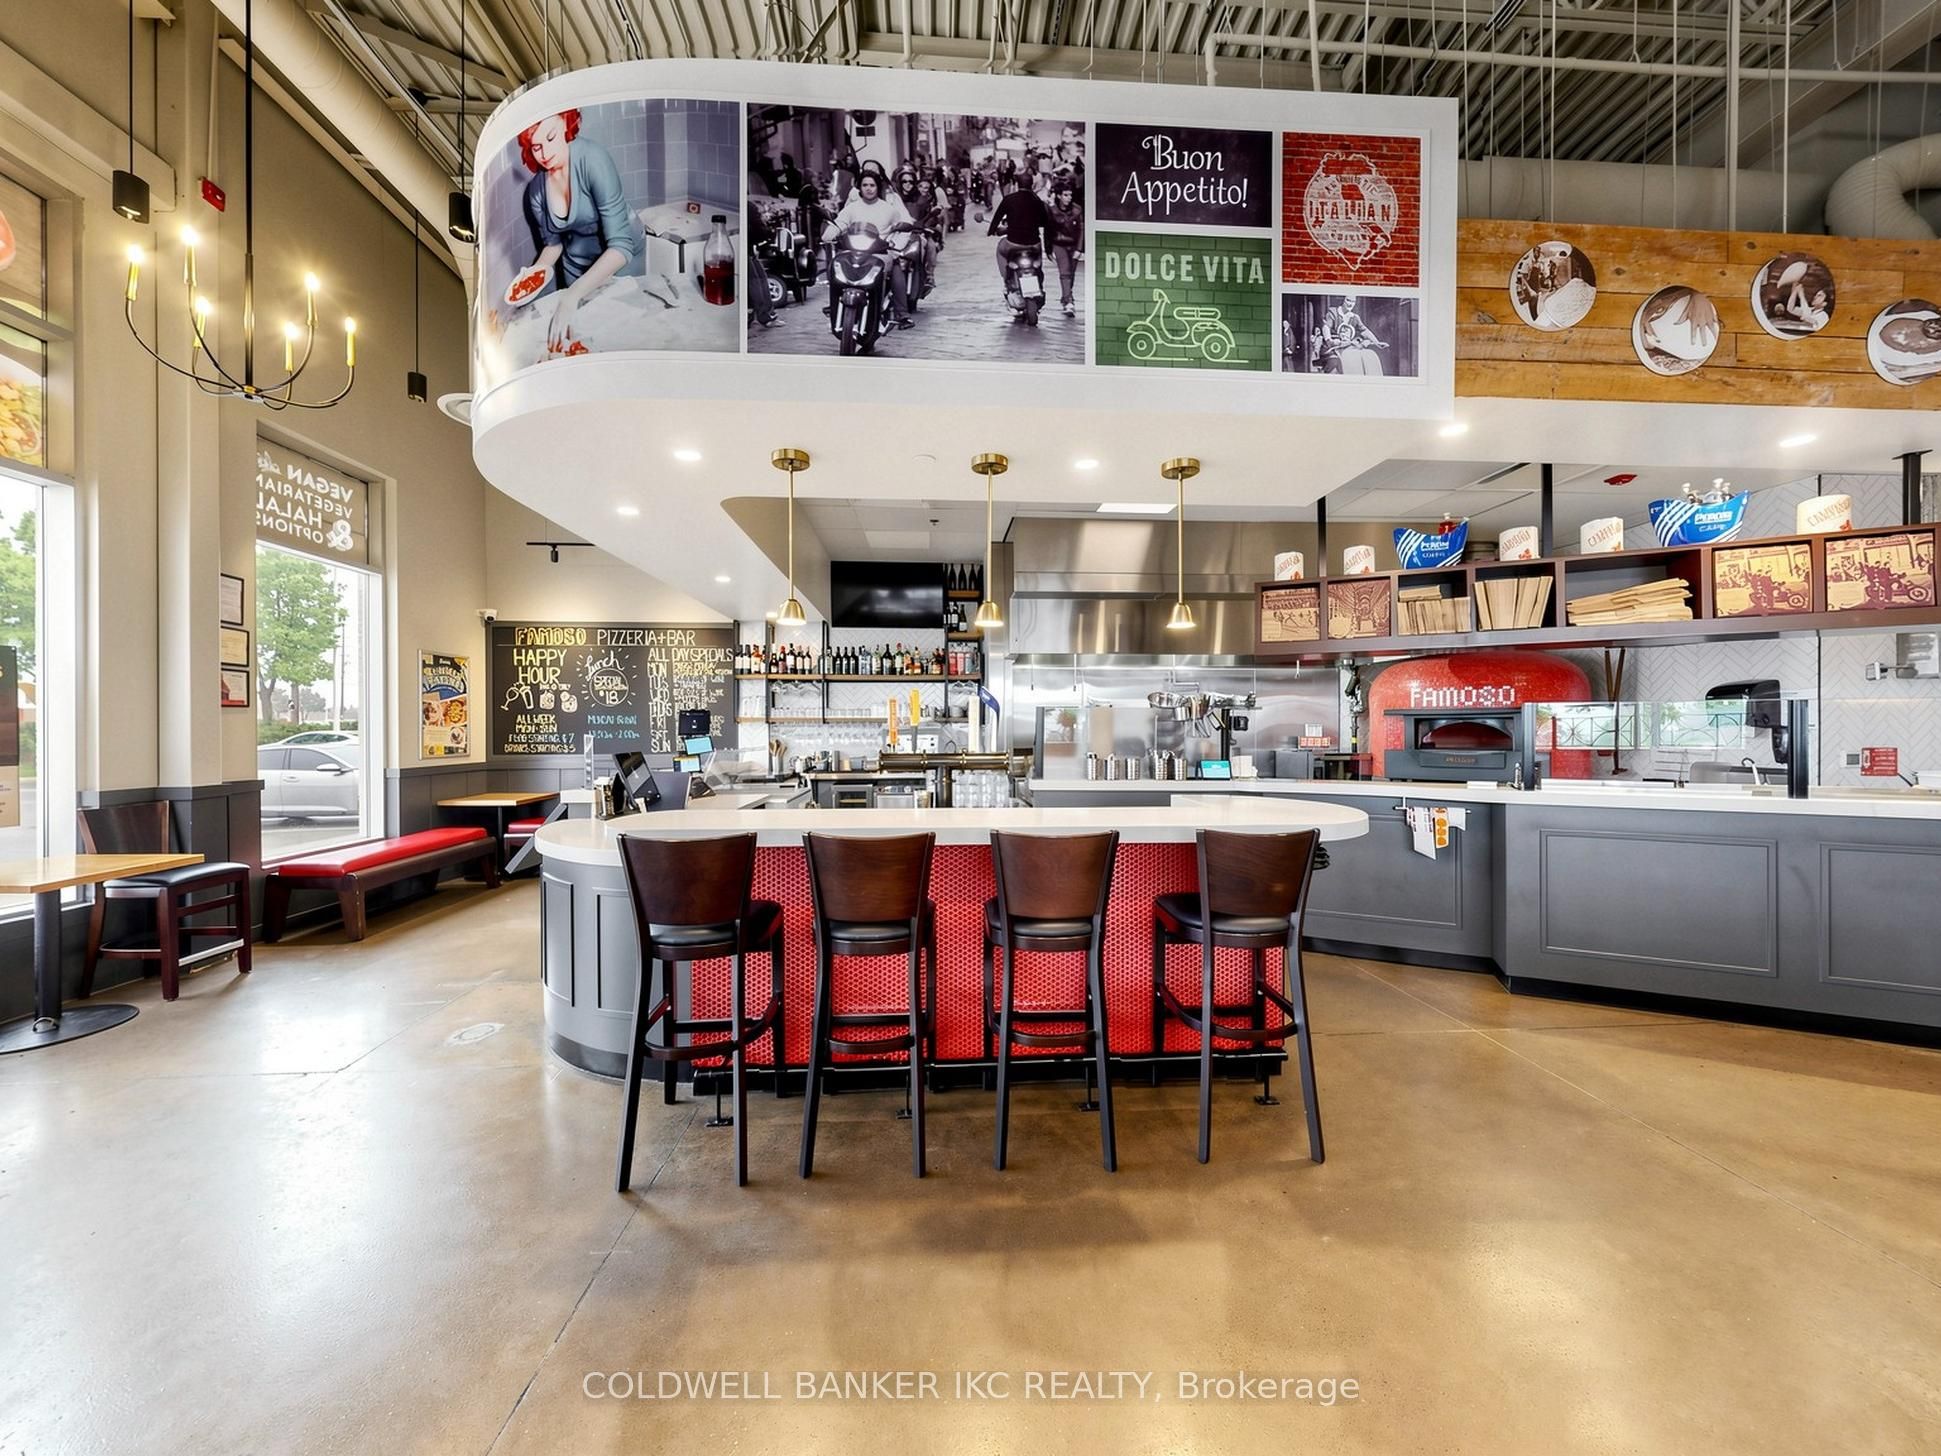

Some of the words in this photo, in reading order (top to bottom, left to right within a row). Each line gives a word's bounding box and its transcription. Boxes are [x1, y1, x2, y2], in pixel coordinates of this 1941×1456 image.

[1142, 134, 1224, 171] Buon
[1121, 171, 1248, 216] Appetito!
[1309, 200, 1391, 222] ITALIAN
[1105, 251, 1194, 282] DOLCE
[1202, 255, 1265, 284] VITA
[515, 627, 587, 646] FAMOSO
[513, 649, 567, 666] HAPPY
[648, 647, 670, 662] ALL
[518, 667, 561, 685] HOUR
[1410, 685, 1515, 708] FAMOSO
